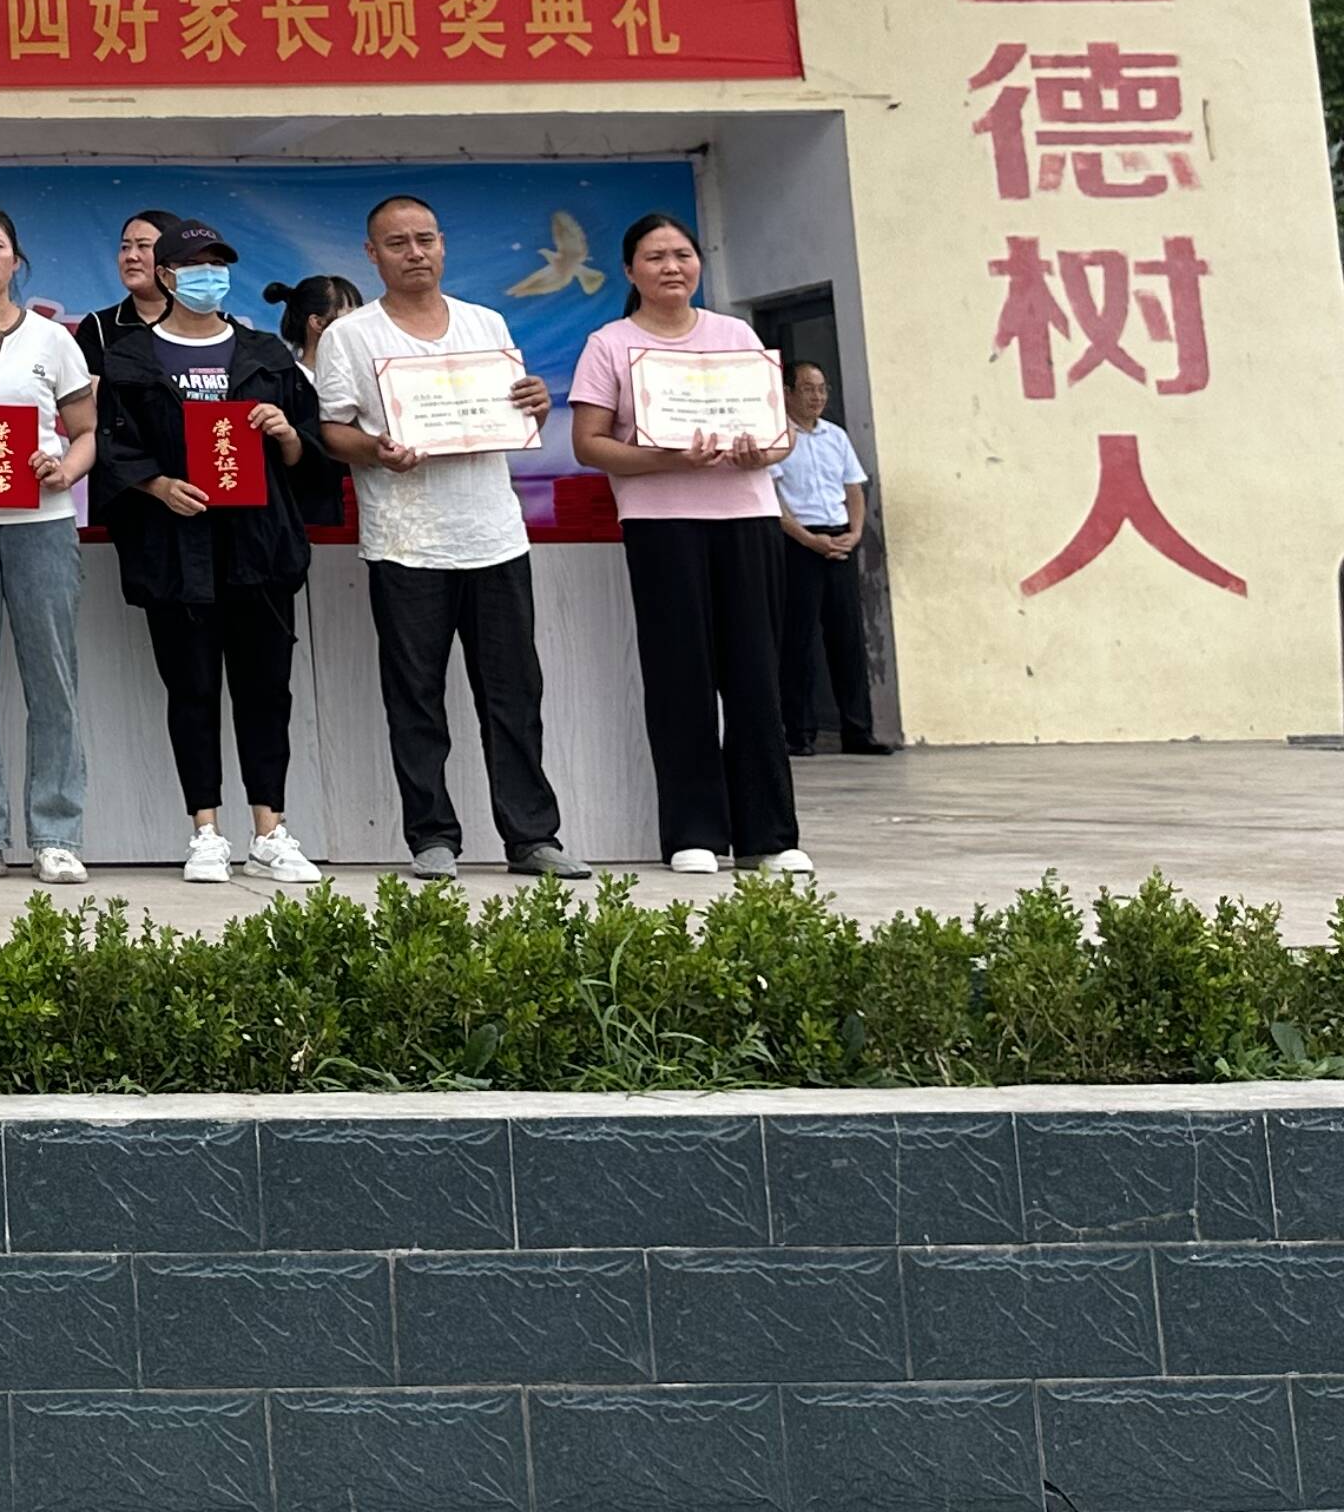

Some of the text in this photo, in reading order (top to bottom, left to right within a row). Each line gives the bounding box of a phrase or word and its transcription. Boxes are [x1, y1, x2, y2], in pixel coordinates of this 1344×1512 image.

[171, 374, 230, 389] ARMO
[211, 416, 240, 492] 荣誉证书
